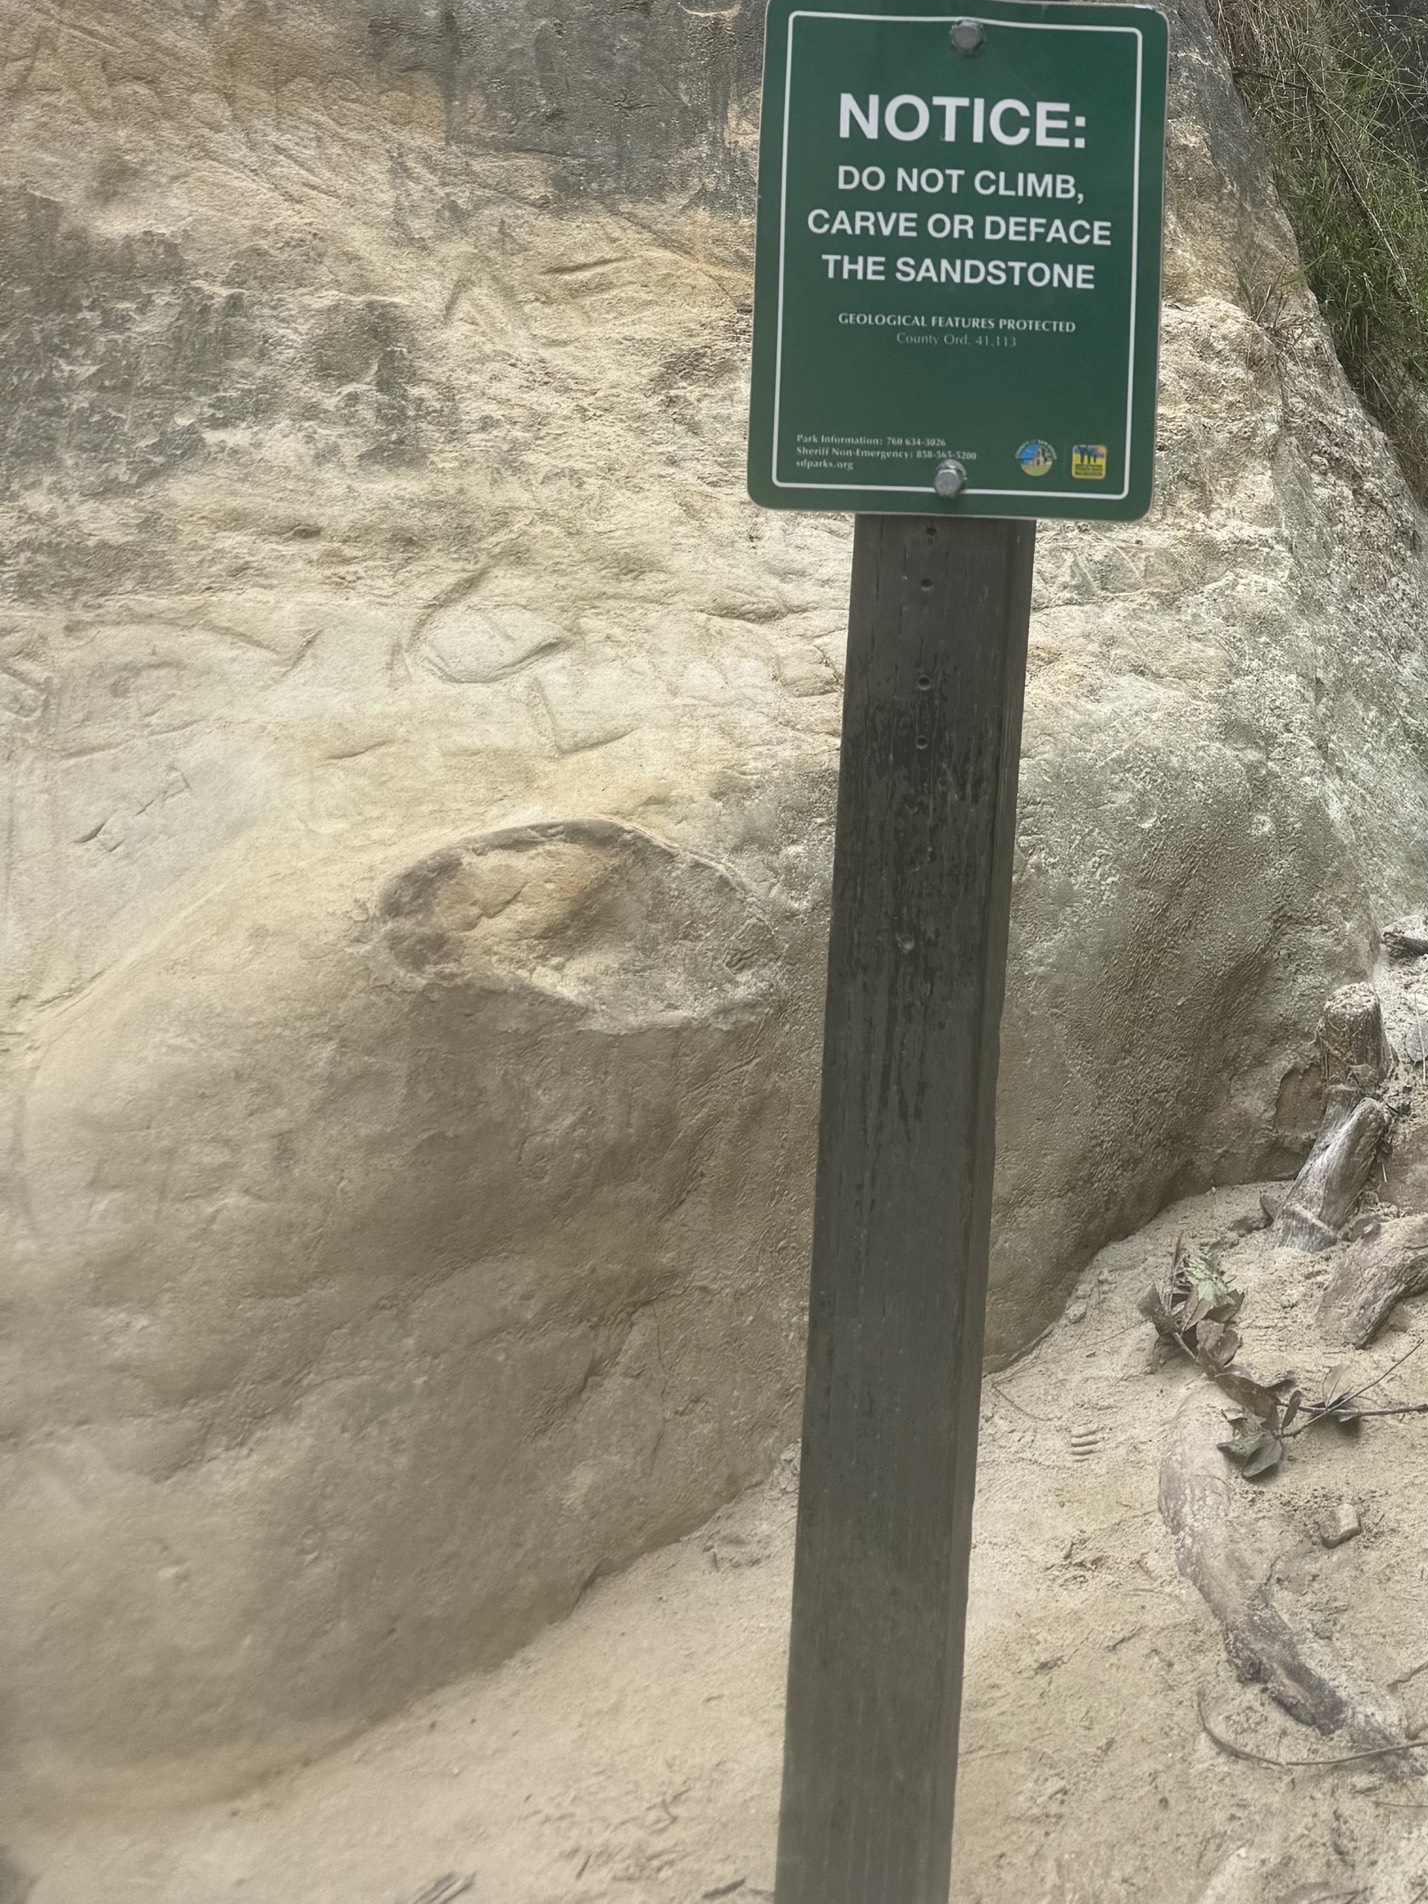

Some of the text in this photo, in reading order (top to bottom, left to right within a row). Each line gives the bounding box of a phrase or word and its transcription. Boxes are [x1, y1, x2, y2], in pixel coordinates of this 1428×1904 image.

[840, 93, 1085, 148] NOTICE:
[838, 166, 1083, 204] DO NOT CLIMB,
[808, 209, 1111, 245] CARVE OR DEFACE
[822, 255, 1094, 289] THE SANDSTONE
[838, 312, 1075, 332] GEOLOGICAL FEATURES PROTECTED
[897, 332, 939, 346] County
[944, 334, 970, 344] Ord.
[797, 434, 818, 443] Park
[821, 435, 882, 445] Information:
[886, 436, 903, 446] 760
[796, 446, 829, 456] Sheriff
[796, 459, 853, 470] sdparks.org
